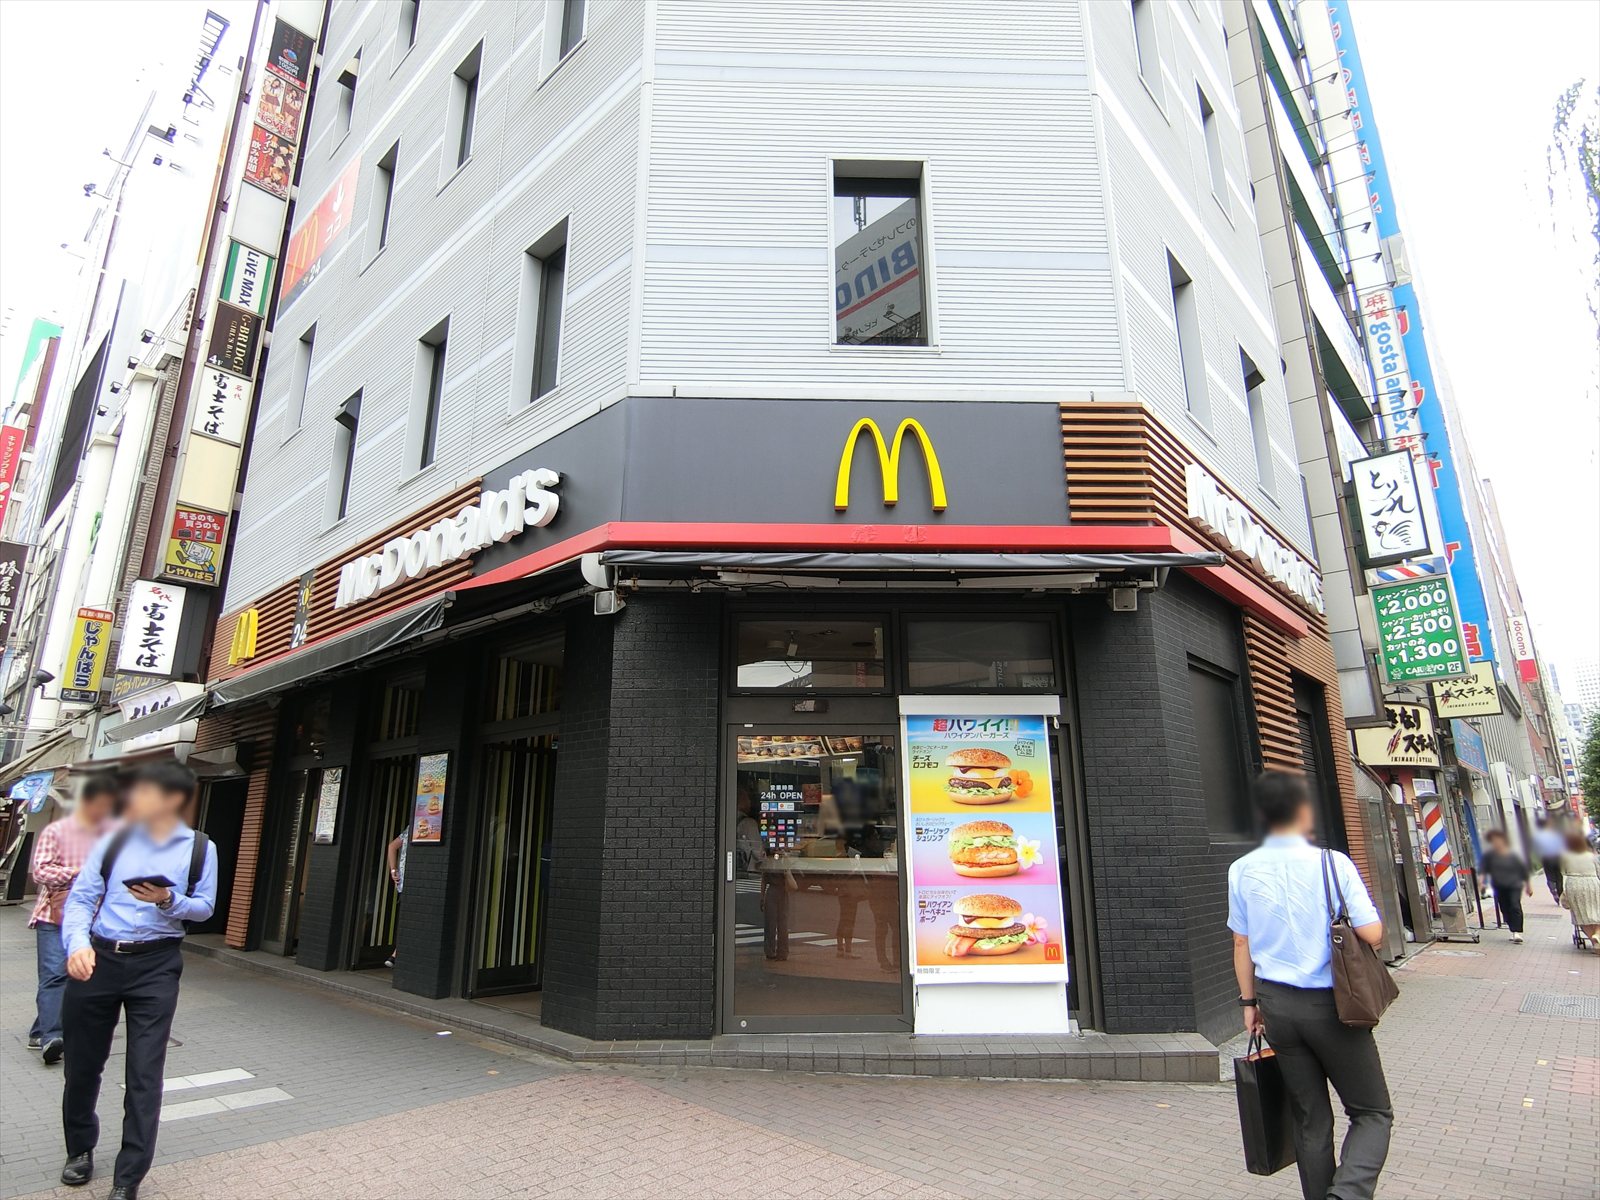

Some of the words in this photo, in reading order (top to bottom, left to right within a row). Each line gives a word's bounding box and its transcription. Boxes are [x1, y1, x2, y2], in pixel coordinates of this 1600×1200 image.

[238, 277, 254, 307] MAX
[1365, 293, 1390, 320] 麻雀
[1369, 321, 1400, 374] gosta
[209, 354, 224, 366] 4F
[204, 373, 230, 435] 富士そば
[179, 511, 215, 523] 売るのも
[185, 520, 221, 531] 買うのも
[334, 467, 560, 610] McDonald's
[135, 602, 169, 668] 富士そば
[1513, 619, 1528, 657] docomo
[1386, 637, 1427, 652] カットのみ
[1449, 662, 1460, 673] 2F
[1455, 685, 1495, 699] ステーキ
[760, 791, 777, 799] 24h
[779, 791, 803, 800] OPEN
[923, 827, 950, 835] ガーリック
[919, 908, 952, 916] バーベキュー
